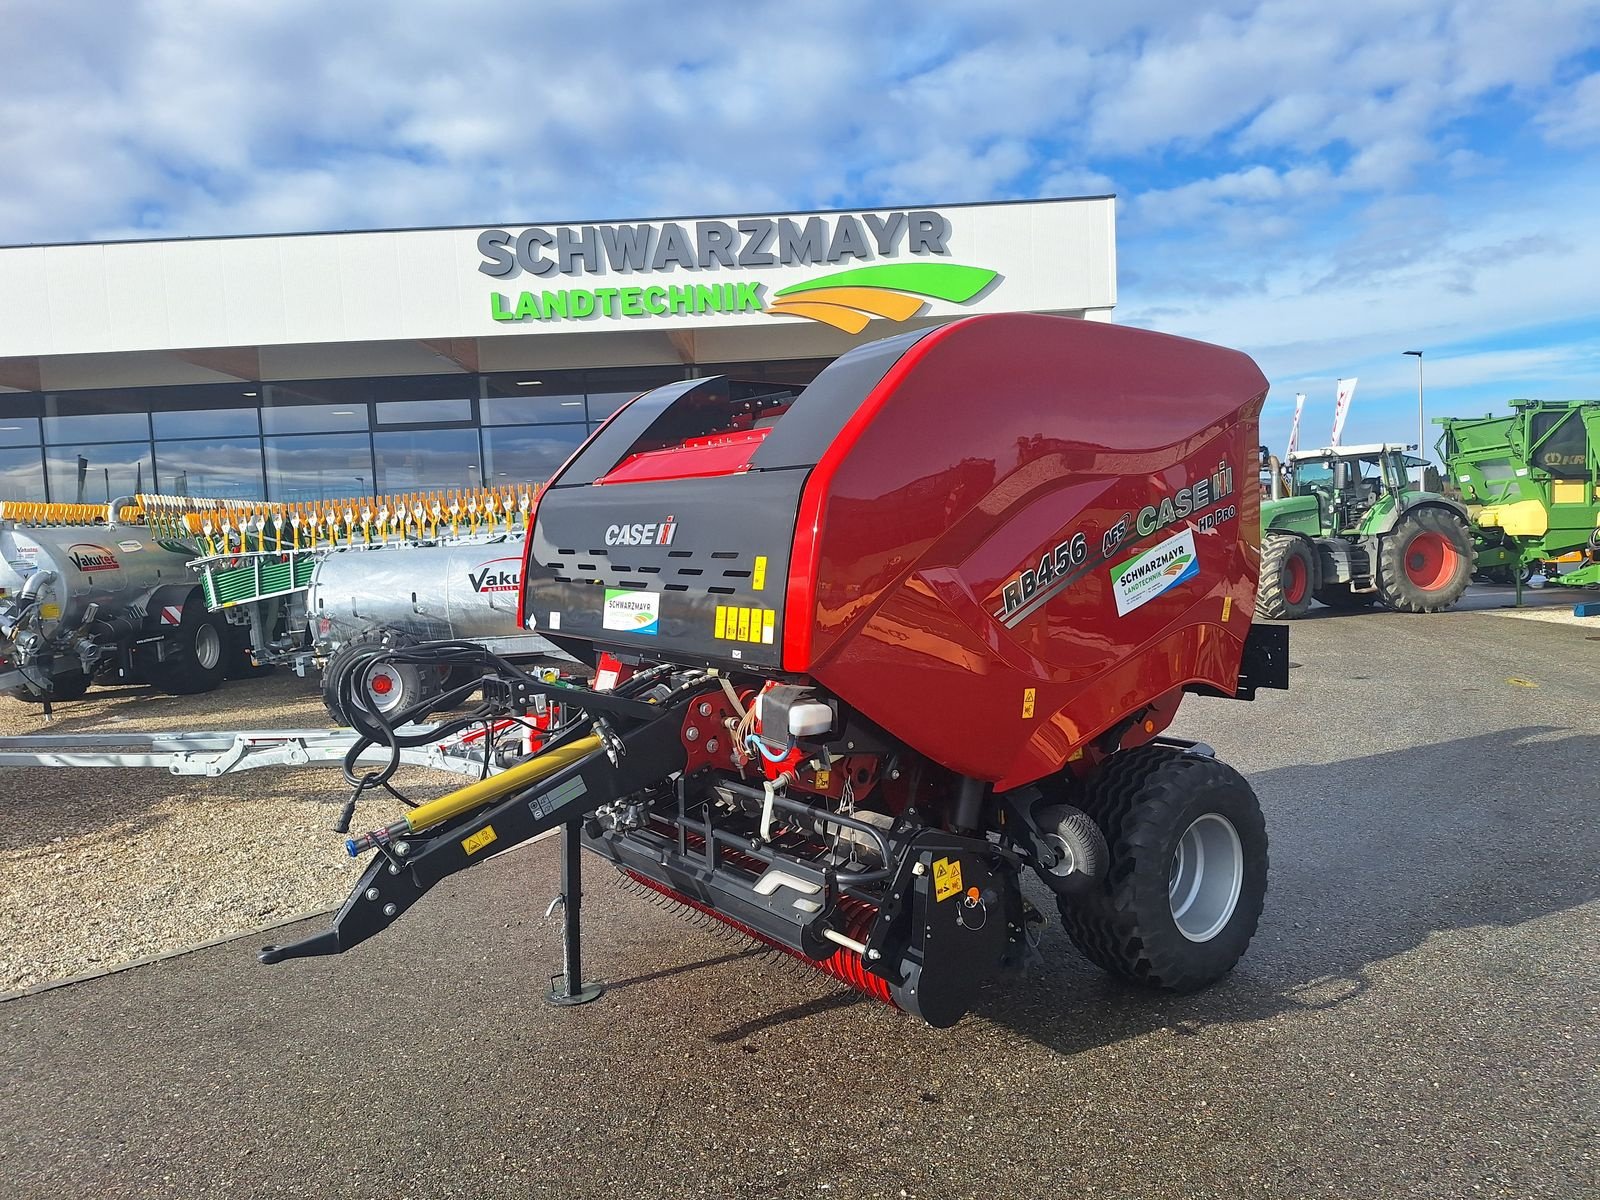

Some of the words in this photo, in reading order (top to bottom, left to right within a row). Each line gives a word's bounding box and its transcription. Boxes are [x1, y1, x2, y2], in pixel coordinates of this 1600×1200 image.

[476, 210, 945, 276] SCHWARZMAYR
[490, 281, 763, 321] LANDTECHNIK
[1136, 478, 1210, 537] CASE
[1197, 513, 1214, 533] HD
[604, 523, 657, 546] CASE
[1101, 518, 1126, 553] AFS
[68, 551, 119, 572] Vakutec
[1002, 532, 1088, 615] RB456
[1120, 545, 1185, 587] SCHWARZMAYR
[1123, 570, 1163, 596] LANDTECHNIK
[608, 600, 651, 611] SCHWARZMAYR
